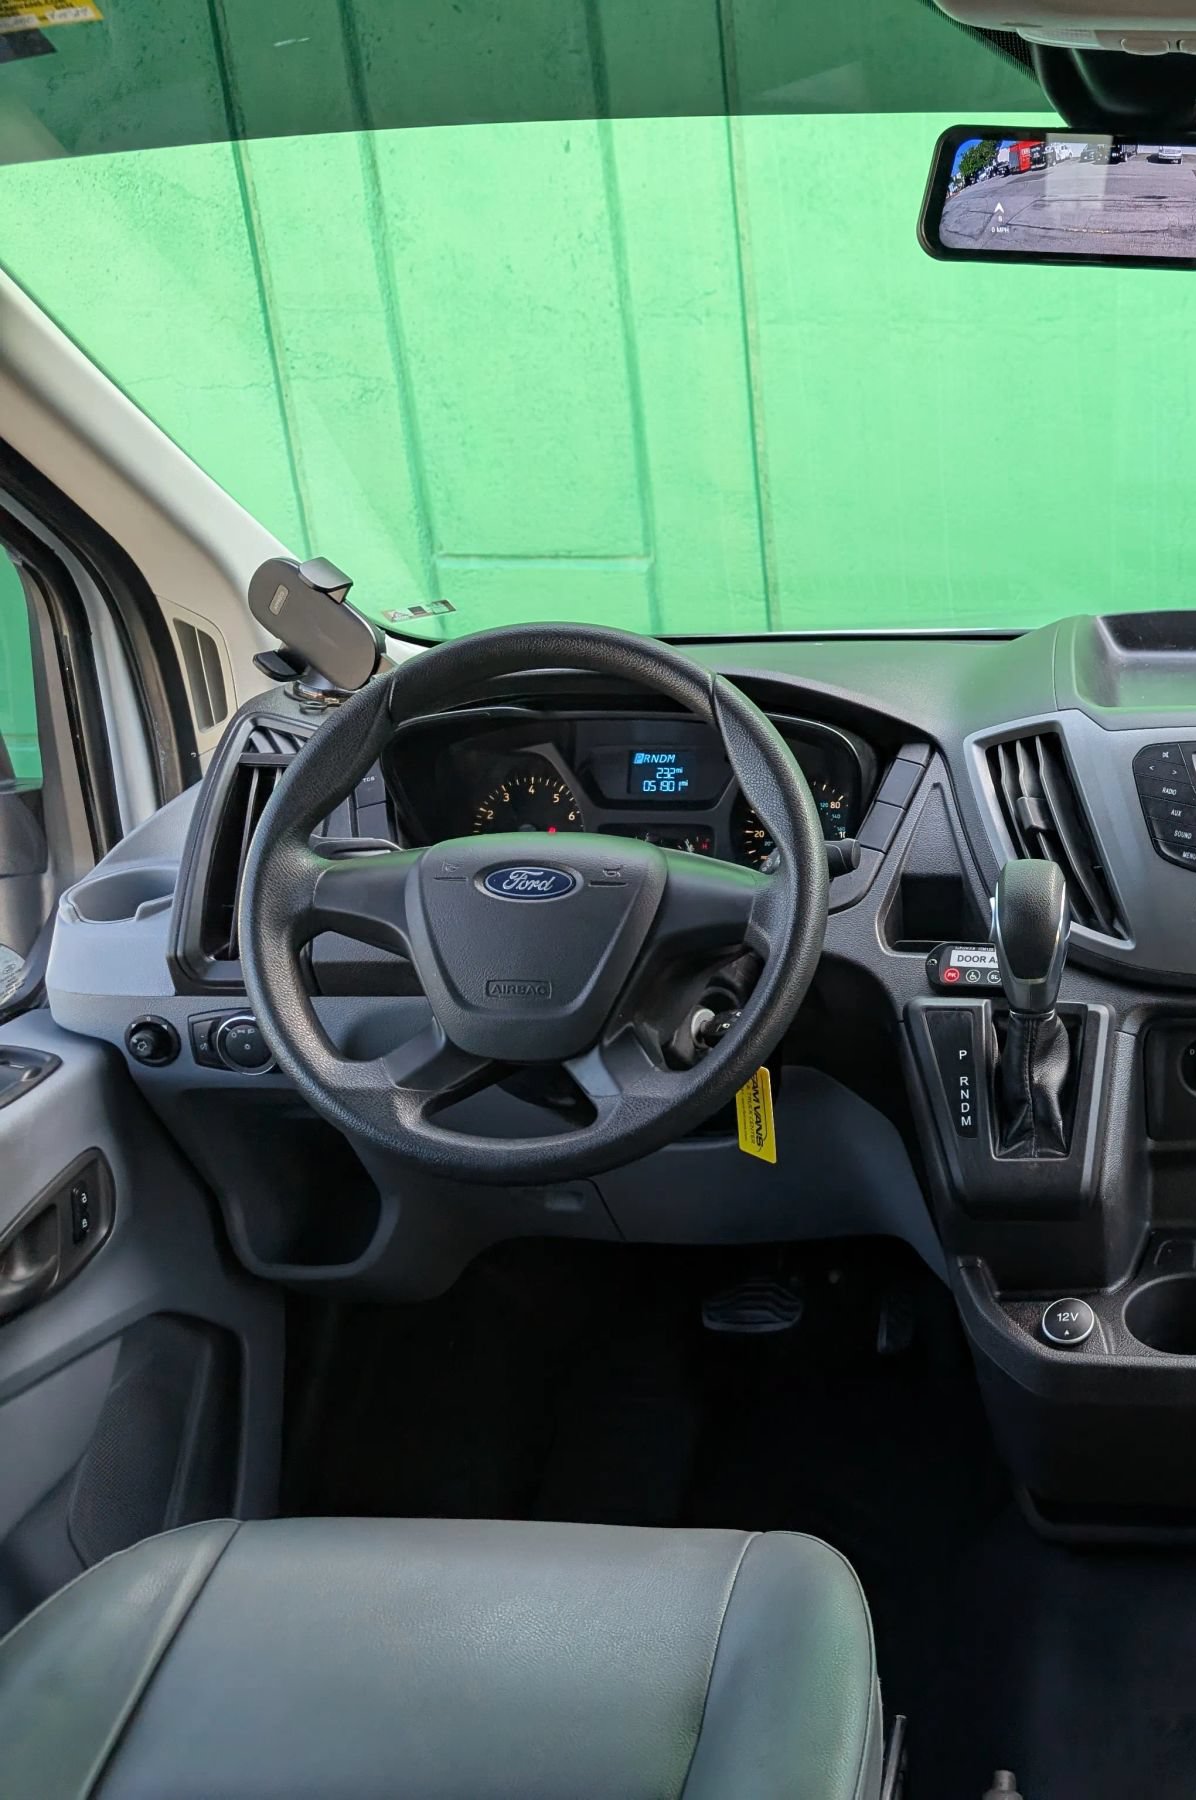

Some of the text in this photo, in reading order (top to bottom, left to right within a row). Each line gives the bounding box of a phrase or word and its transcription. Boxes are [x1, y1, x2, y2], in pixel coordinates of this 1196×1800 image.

[528, 785, 535, 794] 4
[1162, 787, 1177, 796] RADIO
[503, 793, 510, 802] 3
[553, 793, 560, 803] 5
[830, 801, 841, 809] 80
[487, 810, 494, 820] 2
[568, 811, 575, 820] 6
[1170, 809, 1182, 817] AUX
[754, 830, 765, 838] 20
[1174, 830, 1192, 839] SOUND
[502, 870, 554, 892] Ford
[957, 954, 986, 964] DOOR
[490, 983, 547, 995] AIRBAG
[959, 1050, 968, 1060] P
[960, 1076, 969, 1086] R
[960, 1089, 970, 1100] N
[961, 1103, 970, 1113] D
[754, 1105, 764, 1147] VANS
[961, 1116, 972, 1126] M
[1057, 1312, 1079, 1322] 12V
